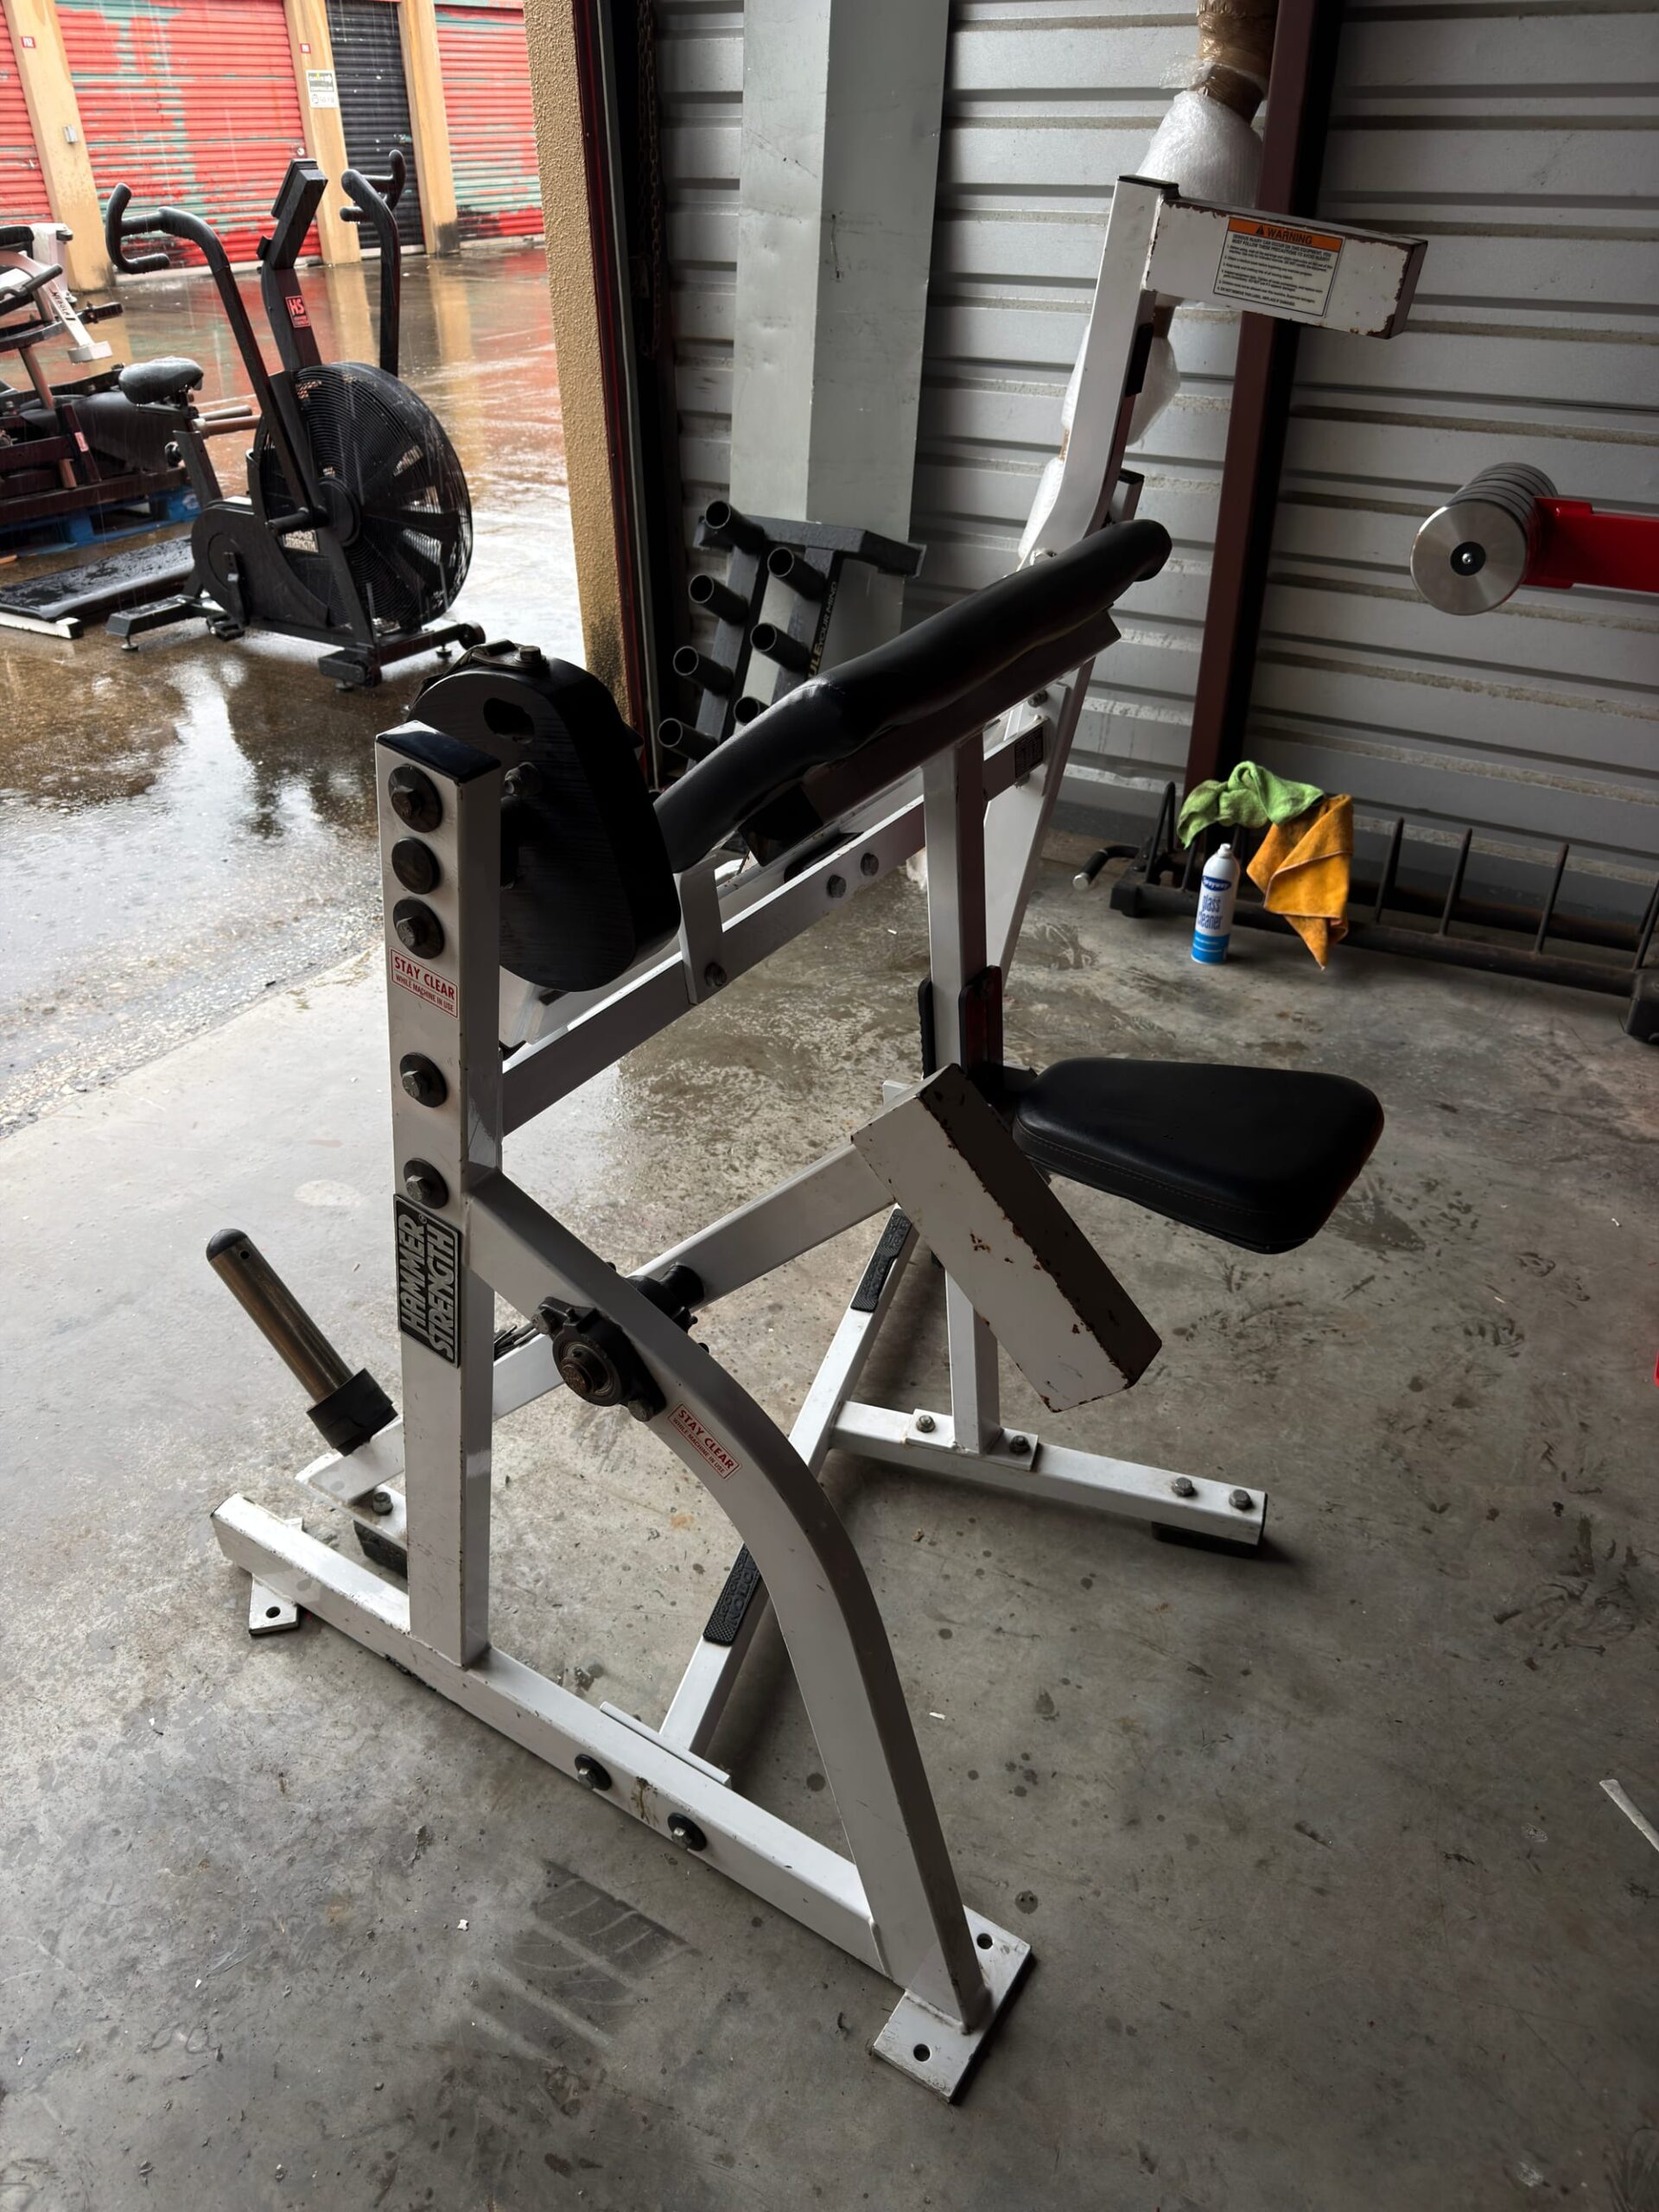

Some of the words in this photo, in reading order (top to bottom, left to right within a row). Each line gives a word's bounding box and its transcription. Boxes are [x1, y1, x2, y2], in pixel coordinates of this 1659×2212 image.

[1268, 226, 1313, 245] WARNING
[289, 299, 305, 315] HS
[808, 643, 822, 678] ULE
[818, 614, 830, 645] YOUR
[826, 581, 837, 613] MIND
[1198, 911, 1224, 930] cleaner
[1202, 894, 1221, 912] glass
[394, 957, 420, 980] STAY
[423, 973, 454, 1001] CLEAR
[395, 974, 413, 988] WHILE
[413, 983, 435, 1002] MACHINE
[436, 996, 443, 1006] IN
[442, 1002, 454, 1013] USE
[398, 1213, 429, 1337] HAMMER
[427, 1224, 454, 1361] STRENGTH
[673, 1417, 689, 1434] WHILE
[687, 1433, 709, 1457] MACHINE
[714, 1462, 725, 1473] USE
[678, 1409, 704, 1436] STAY
[704, 1437, 734, 1469] CLEAR
